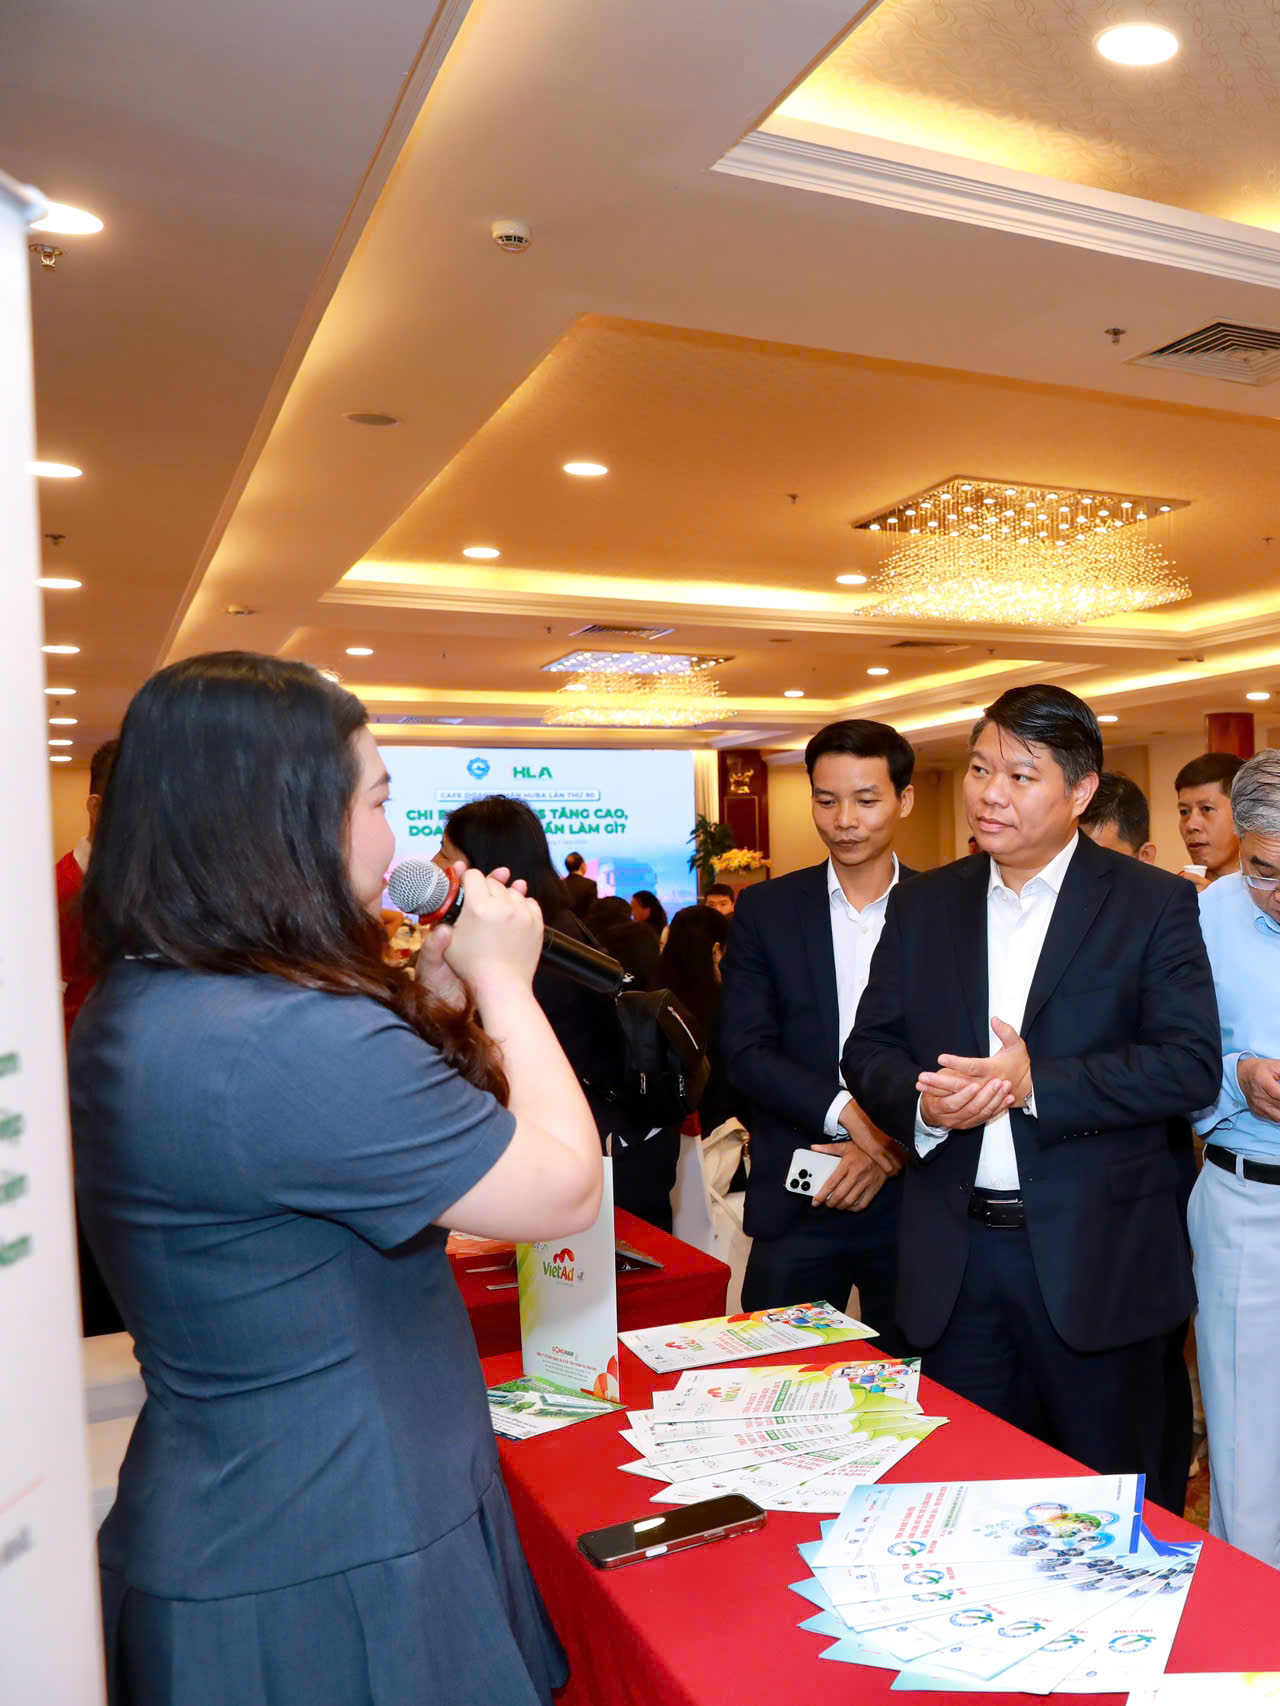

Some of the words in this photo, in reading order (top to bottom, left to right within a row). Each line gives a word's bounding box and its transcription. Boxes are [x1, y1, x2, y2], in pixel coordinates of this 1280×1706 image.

[513, 766, 553, 779] HLA
[405, 809, 434, 821] CHI
[549, 806, 590, 820] TĂNG
[593, 808, 629, 821] CAO,
[569, 821, 601, 835] LÀM
[604, 821, 627, 834] GÌ?
[543, 1260, 575, 1282] VietAd
